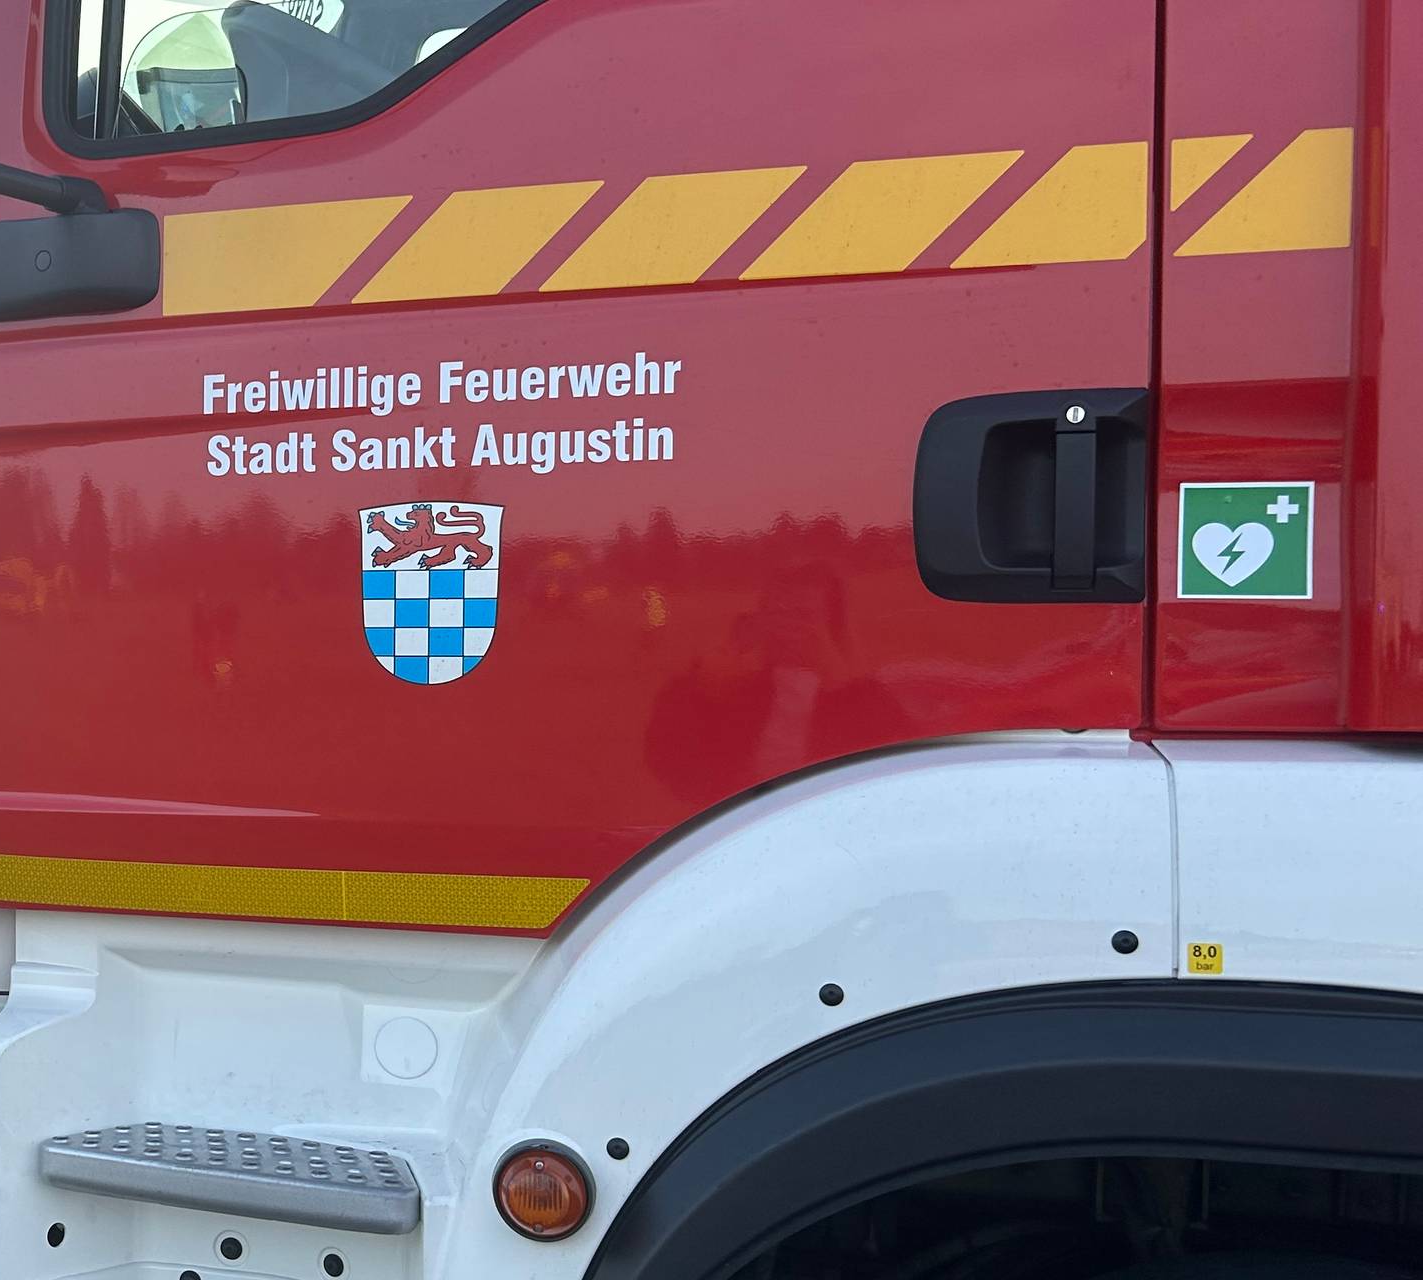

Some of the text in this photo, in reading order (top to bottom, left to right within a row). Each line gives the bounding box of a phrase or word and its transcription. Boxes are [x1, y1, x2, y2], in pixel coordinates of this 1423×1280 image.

[202, 351, 682, 417] Freiwillige Feuerwehr
[207, 417, 674, 477] Stadt Sankt Augustin
[1192, 945, 1217, 960] 8,0
[1195, 961, 1214, 971] bar
